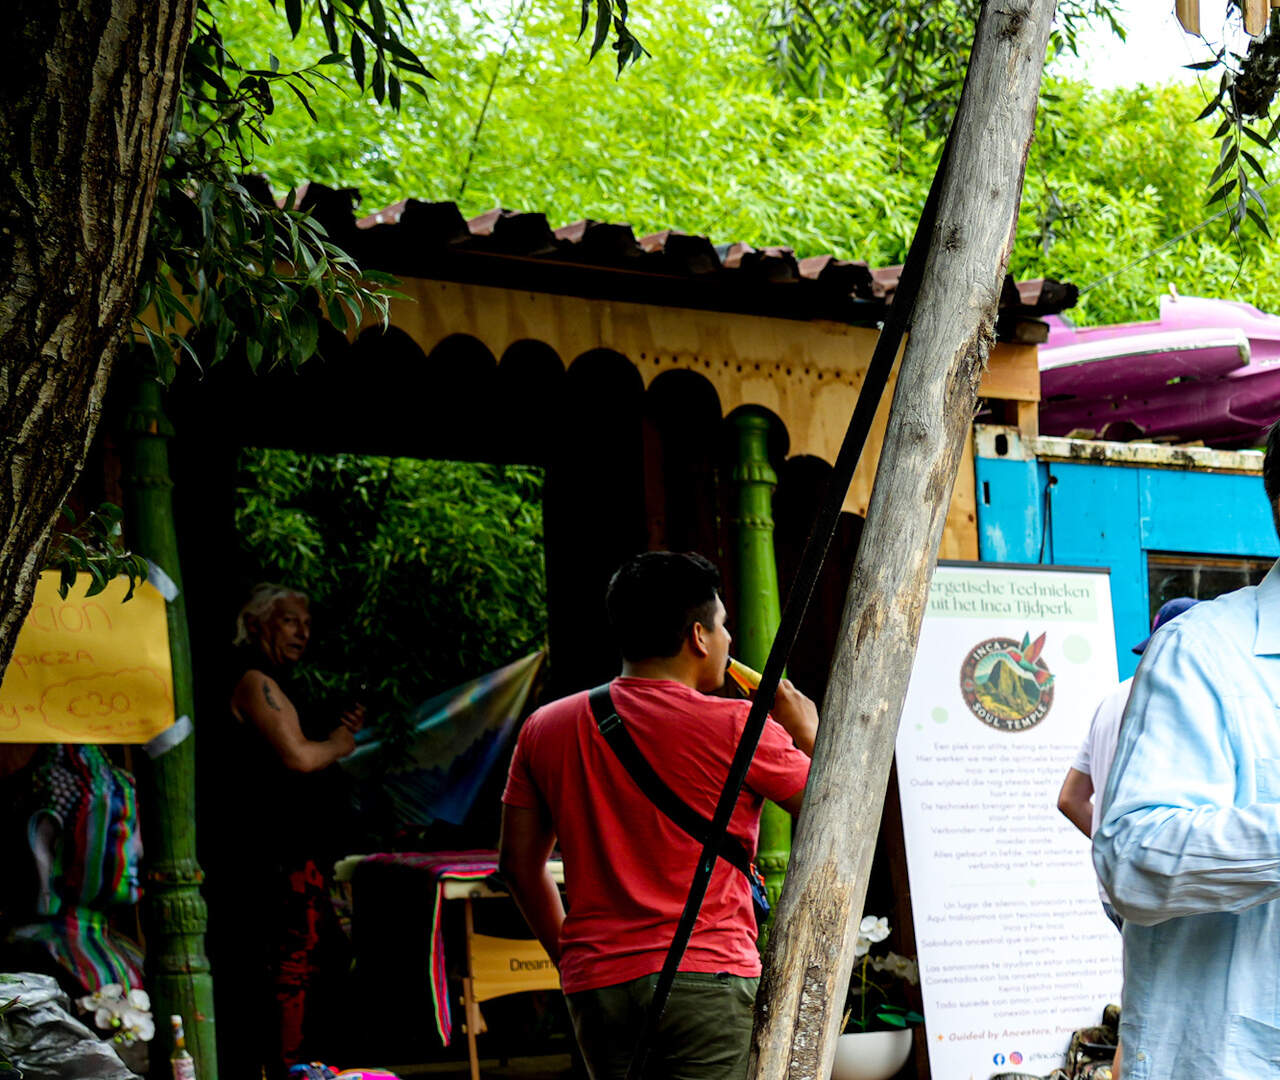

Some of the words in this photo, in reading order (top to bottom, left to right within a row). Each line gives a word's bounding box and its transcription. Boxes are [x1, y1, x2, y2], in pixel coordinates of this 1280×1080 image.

[929, 579, 1004, 597] ergetische
[954, 596, 976, 613] het
[980, 599, 1011, 613] Inca
[1015, 599, 1073, 617] Tijdperk
[973, 641, 1001, 661] INCA
[972, 702, 1000, 728] SOUL
[1006, 704, 1049, 730] TEMPLE
